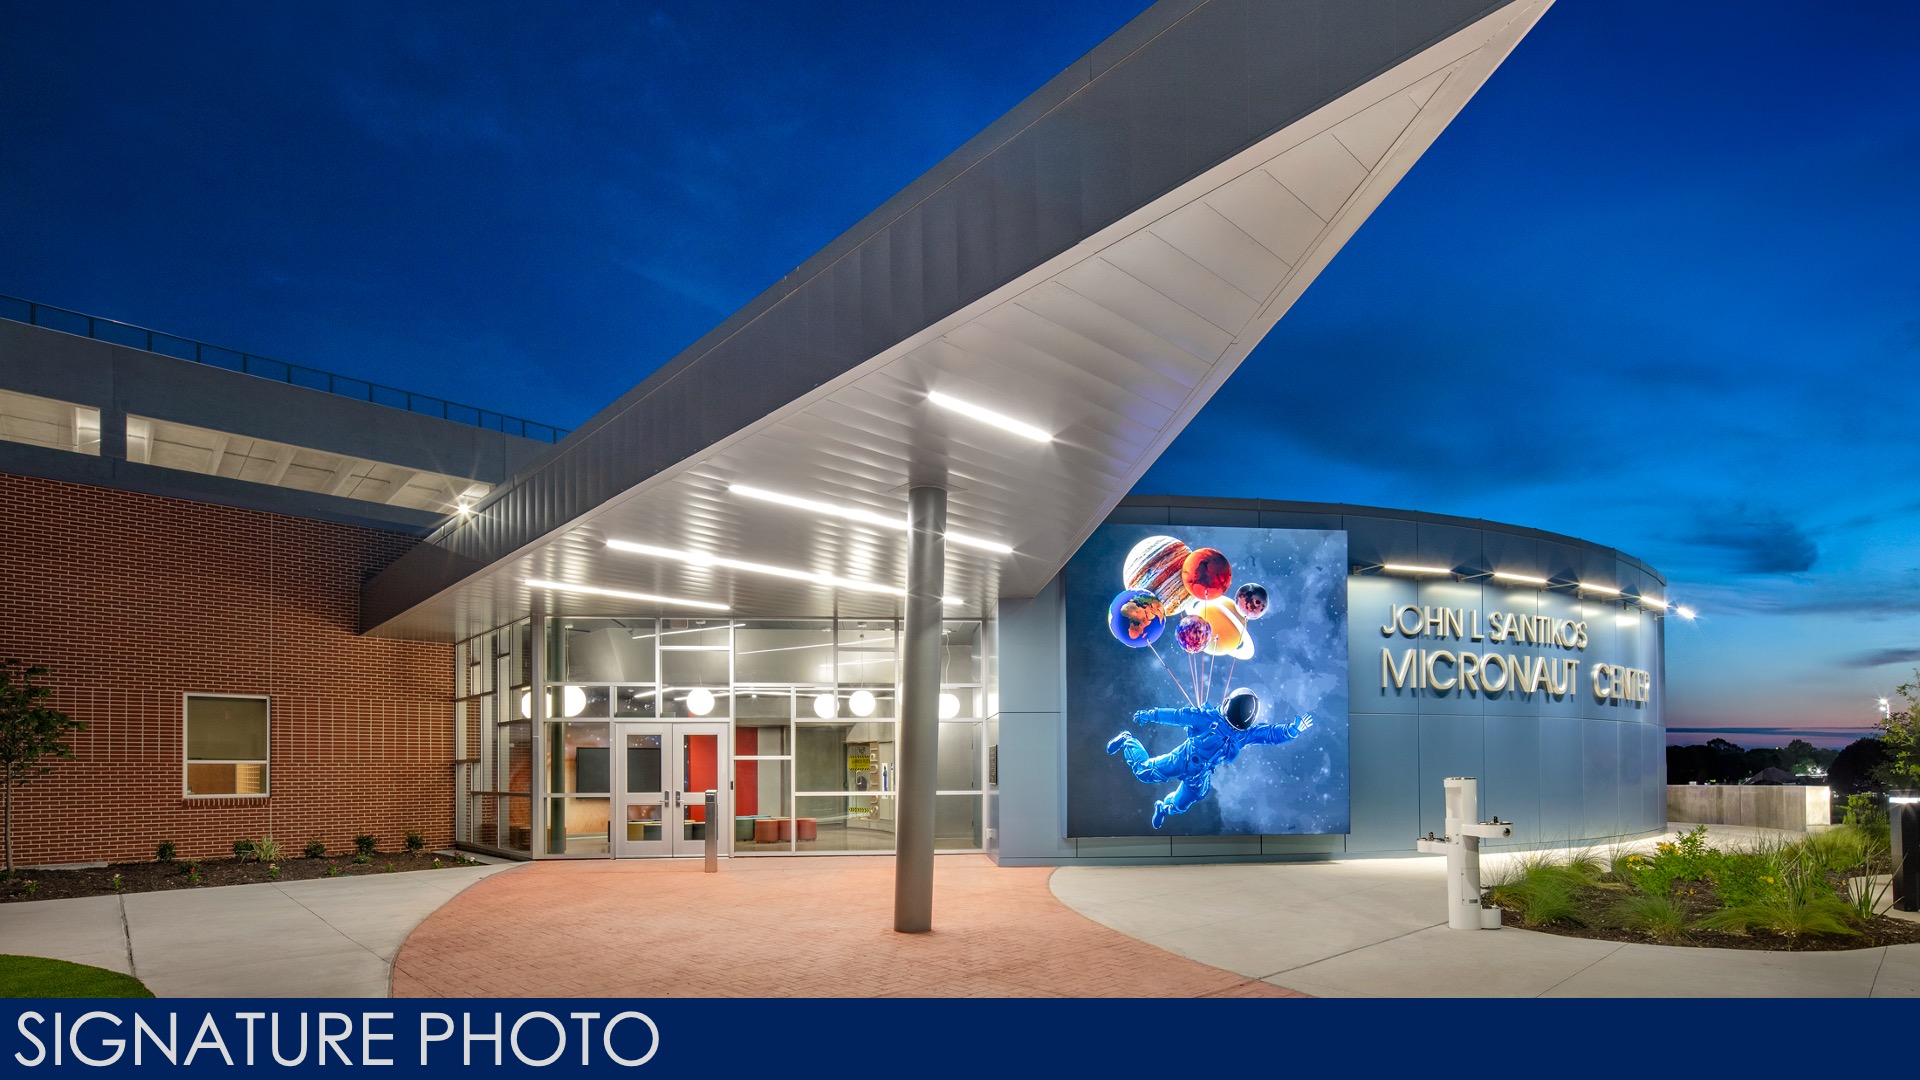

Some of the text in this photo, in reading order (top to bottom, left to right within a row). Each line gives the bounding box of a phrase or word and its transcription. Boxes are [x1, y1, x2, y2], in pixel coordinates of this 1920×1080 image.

[1381, 604, 1589, 649] JOHN L SANTIKOS
[1381, 648, 1650, 702] MICRONAUT CENTER
[870, 780, 879, 815] SUT
